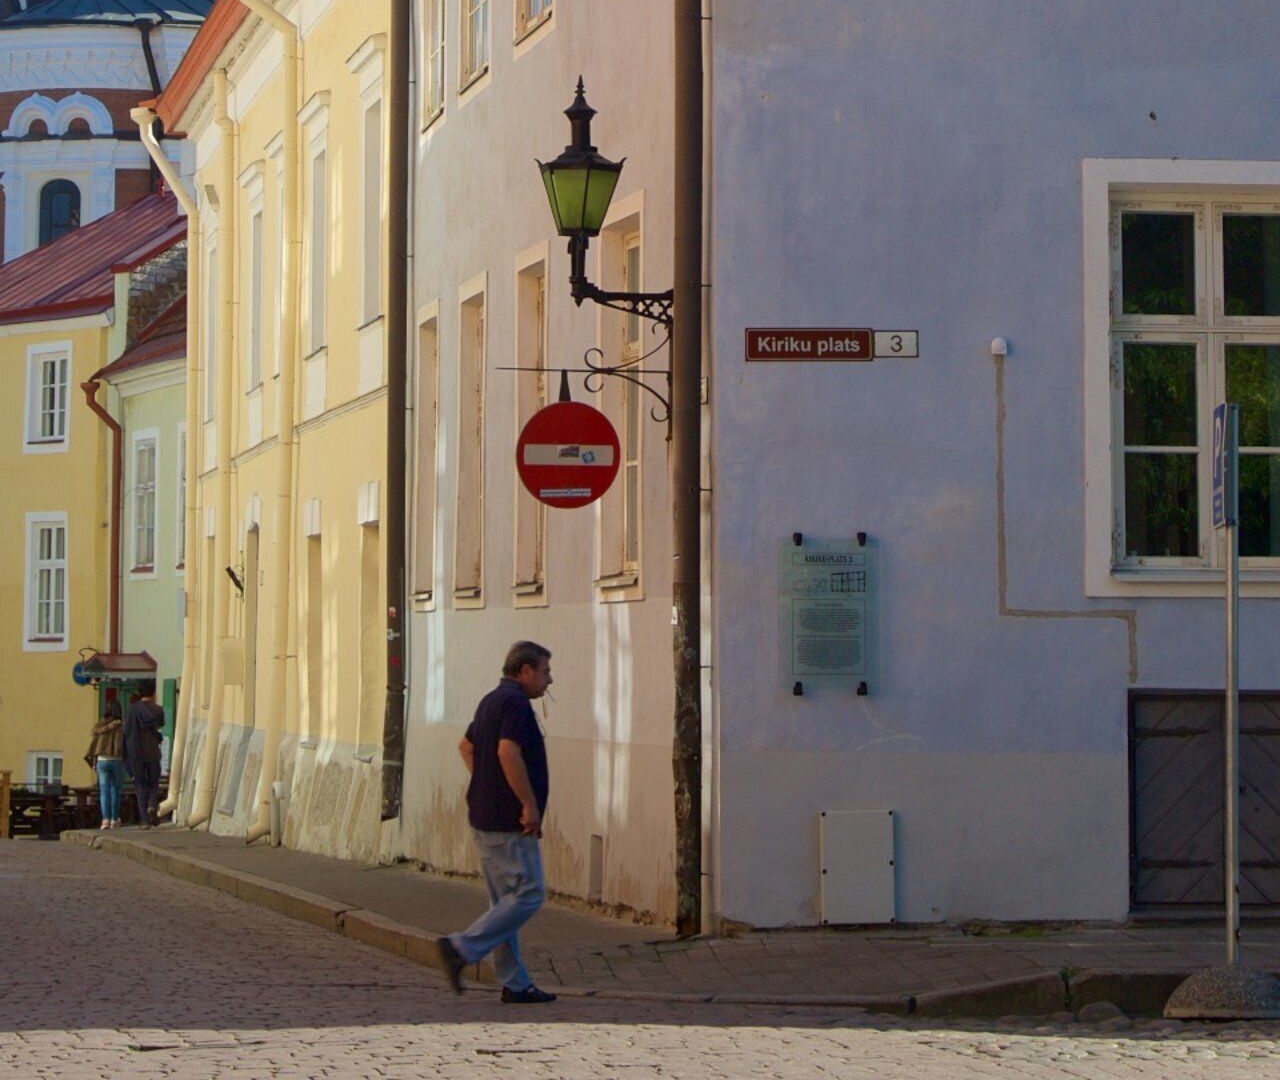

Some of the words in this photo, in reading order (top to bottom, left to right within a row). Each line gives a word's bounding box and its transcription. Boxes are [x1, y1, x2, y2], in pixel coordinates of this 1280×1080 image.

[757, 336, 811, 352] Kiriku
[817, 336, 861, 356] plats
[890, 335, 903, 353] 3
